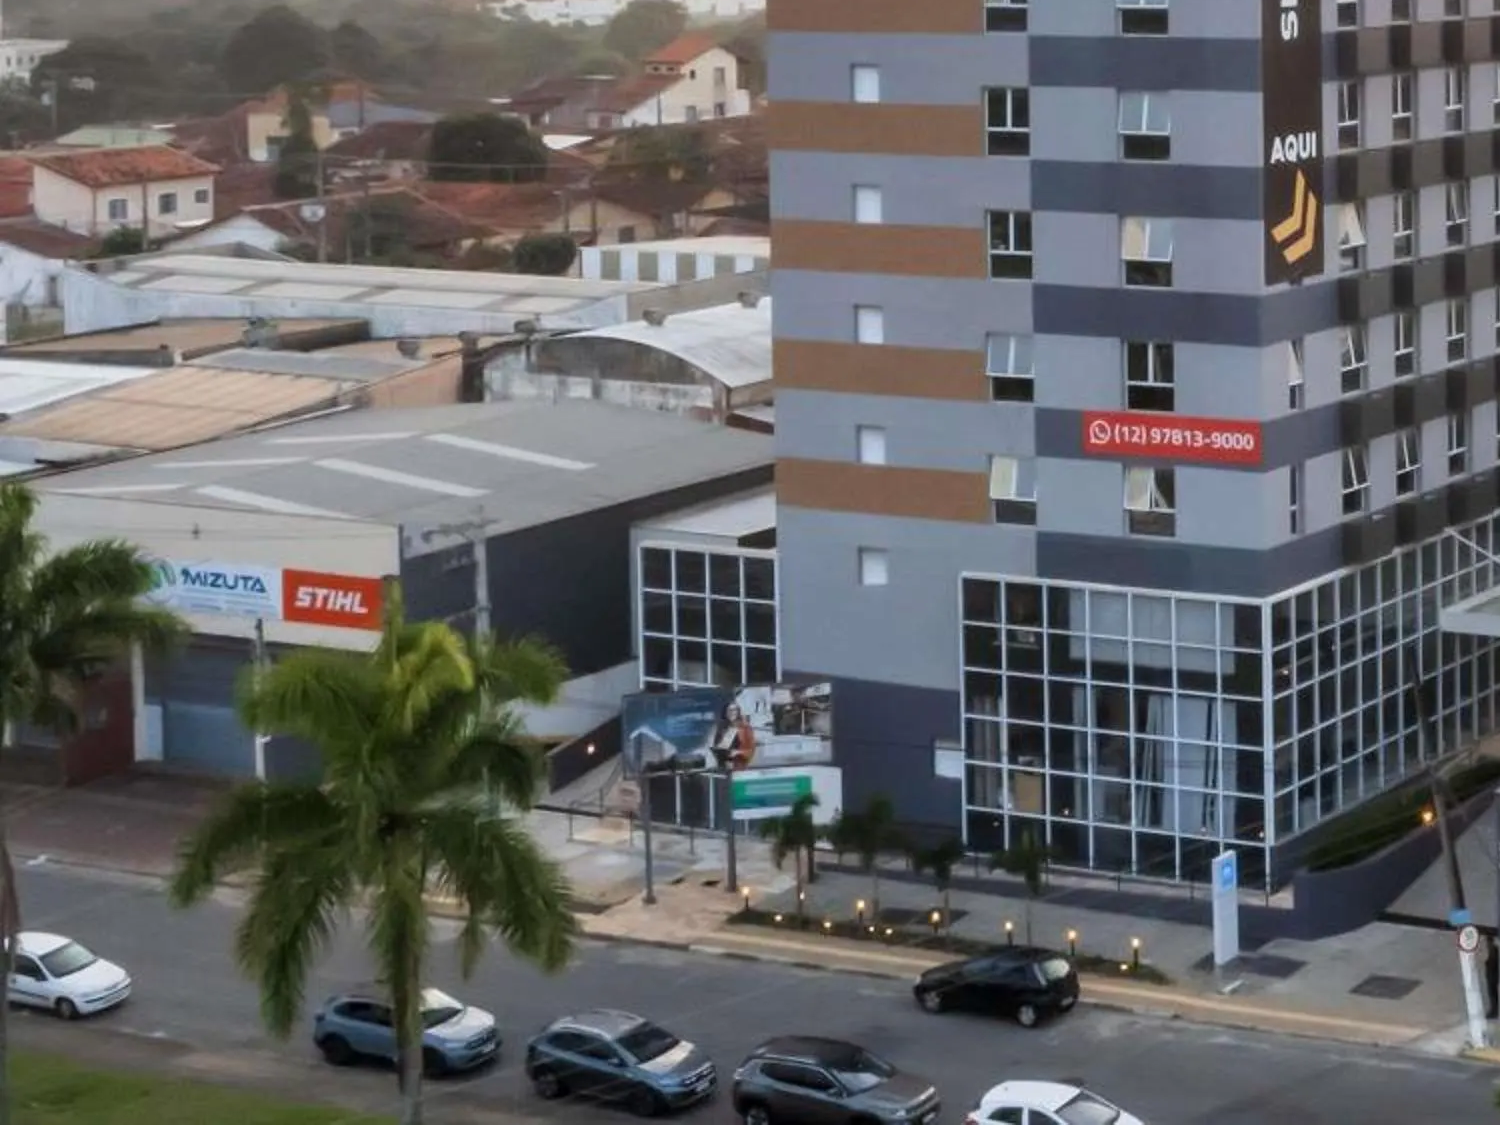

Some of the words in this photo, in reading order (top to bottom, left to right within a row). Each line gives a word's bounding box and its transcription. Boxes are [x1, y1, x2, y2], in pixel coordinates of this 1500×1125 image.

[1270, 131, 1317, 165] AQUI
[1114, 425, 1148, 446] (12)
[1151, 427, 1255, 452] 97813-9000
[181, 567, 268, 594] MIZUTA
[293, 585, 369, 615] STIHL
